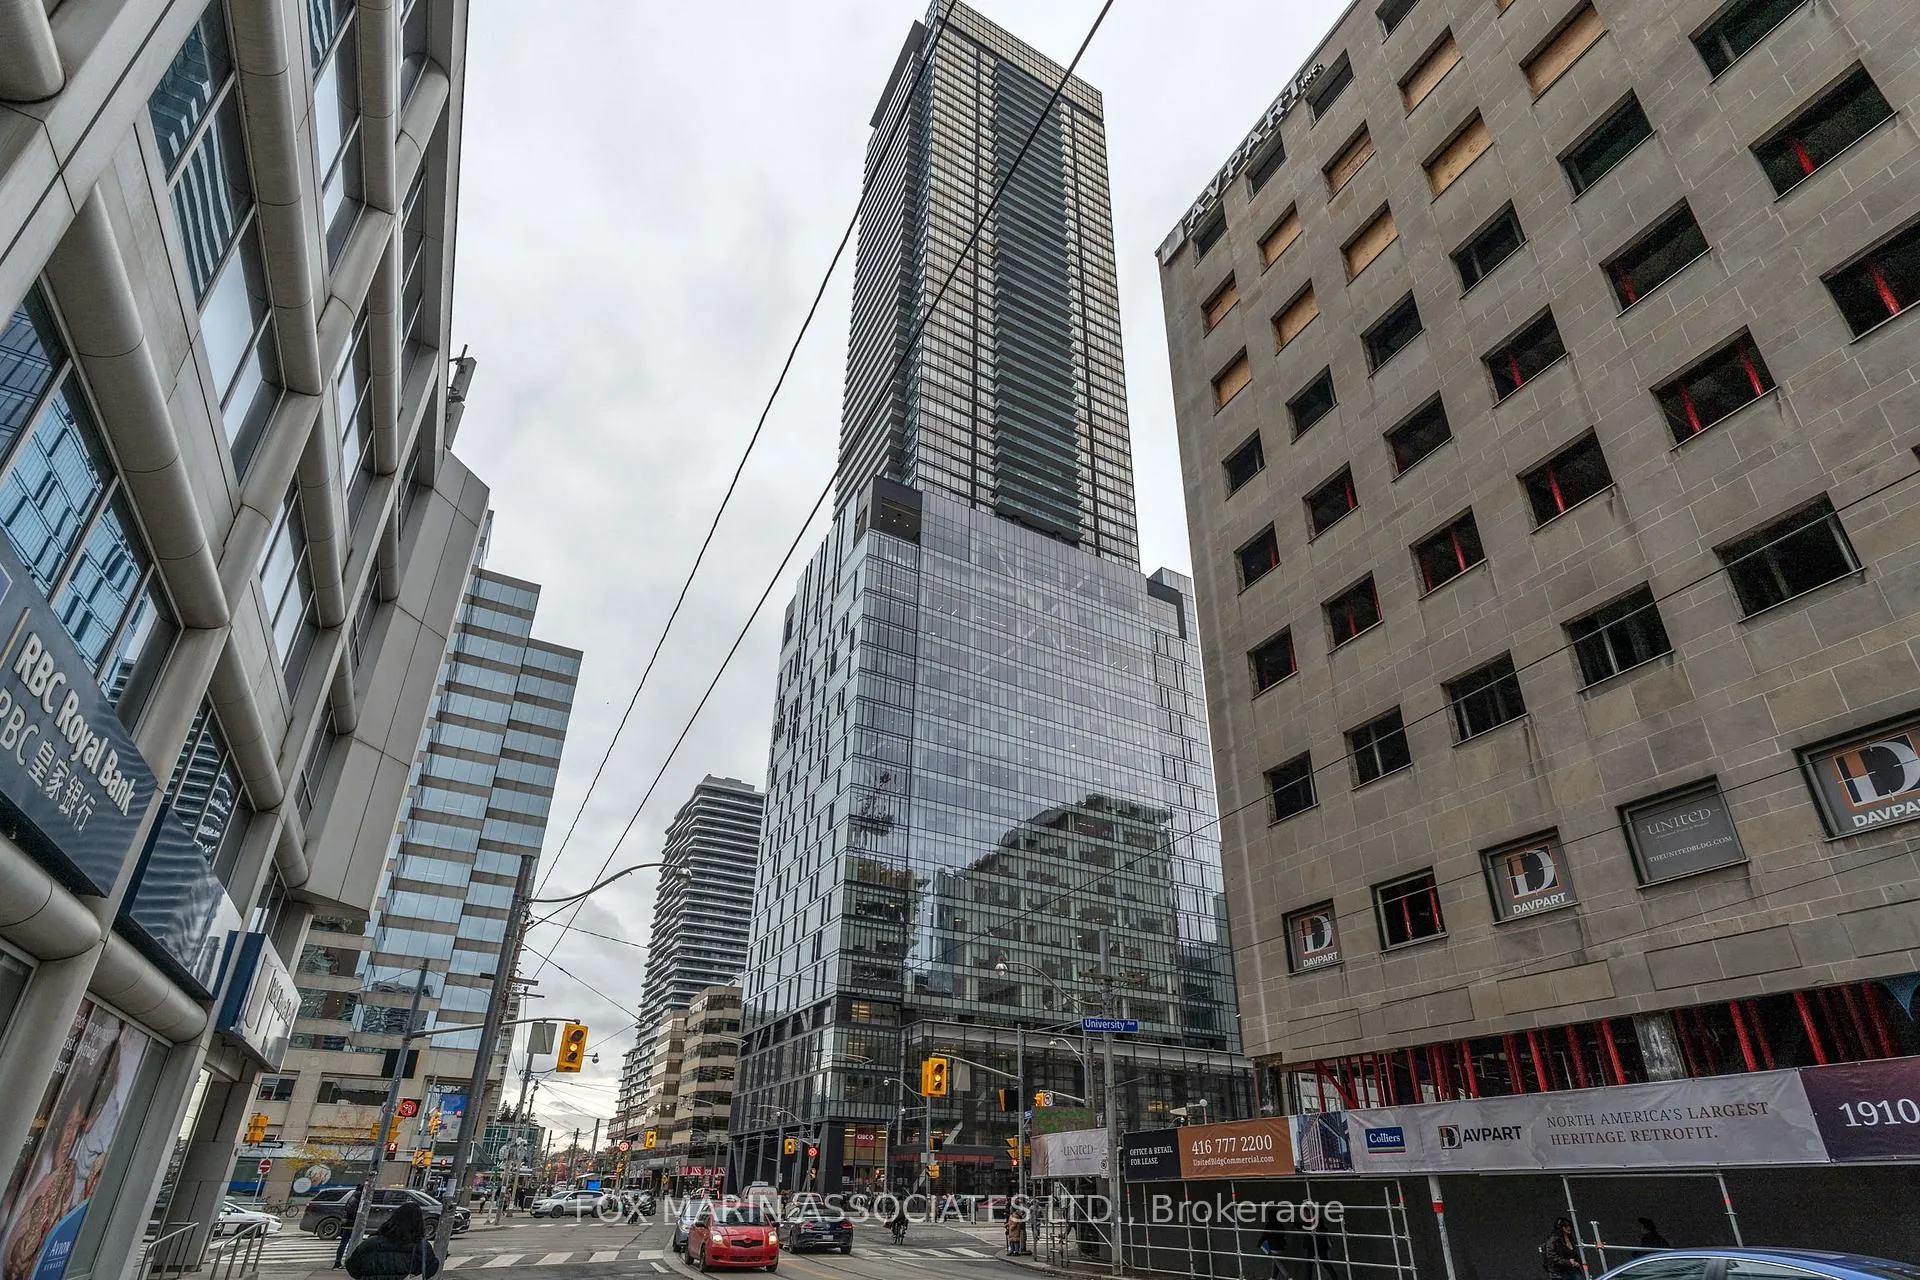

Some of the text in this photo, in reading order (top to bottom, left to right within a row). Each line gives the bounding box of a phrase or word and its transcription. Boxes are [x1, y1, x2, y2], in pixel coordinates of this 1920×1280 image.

[14, 632, 137, 816] RBC Royal Bank
[27, 740, 97, 832] 皇家銀行
[1852, 799, 1920, 828] DAVPA
[1649, 836, 1732, 863] THEUNITEDBLDG.COM
[1512, 892, 1566, 914] DAVPART
[1303, 951, 1338, 967] DAVPART
[1085, 1019, 1125, 1031] University
[1547, 1114, 1596, 1128] NORTH
[1687, 1102, 1769, 1120] LARGEST
[1838, 1098, 1920, 1127] 1910
[1191, 1134, 1273, 1155] 416 777 2200
[1369, 1132, 1401, 1144] Colliers
[1551, 1125, 1718, 1146] HERITAGE RETROFIT.
[1129, 1147, 1149, 1156] OFFICE
[1154, 1145, 1173, 1155] RETAIL
[1130, 1157, 1158, 1166] FOR LEASE
[1193, 1155, 1275, 1168] UnitedBldgCommercial.com
